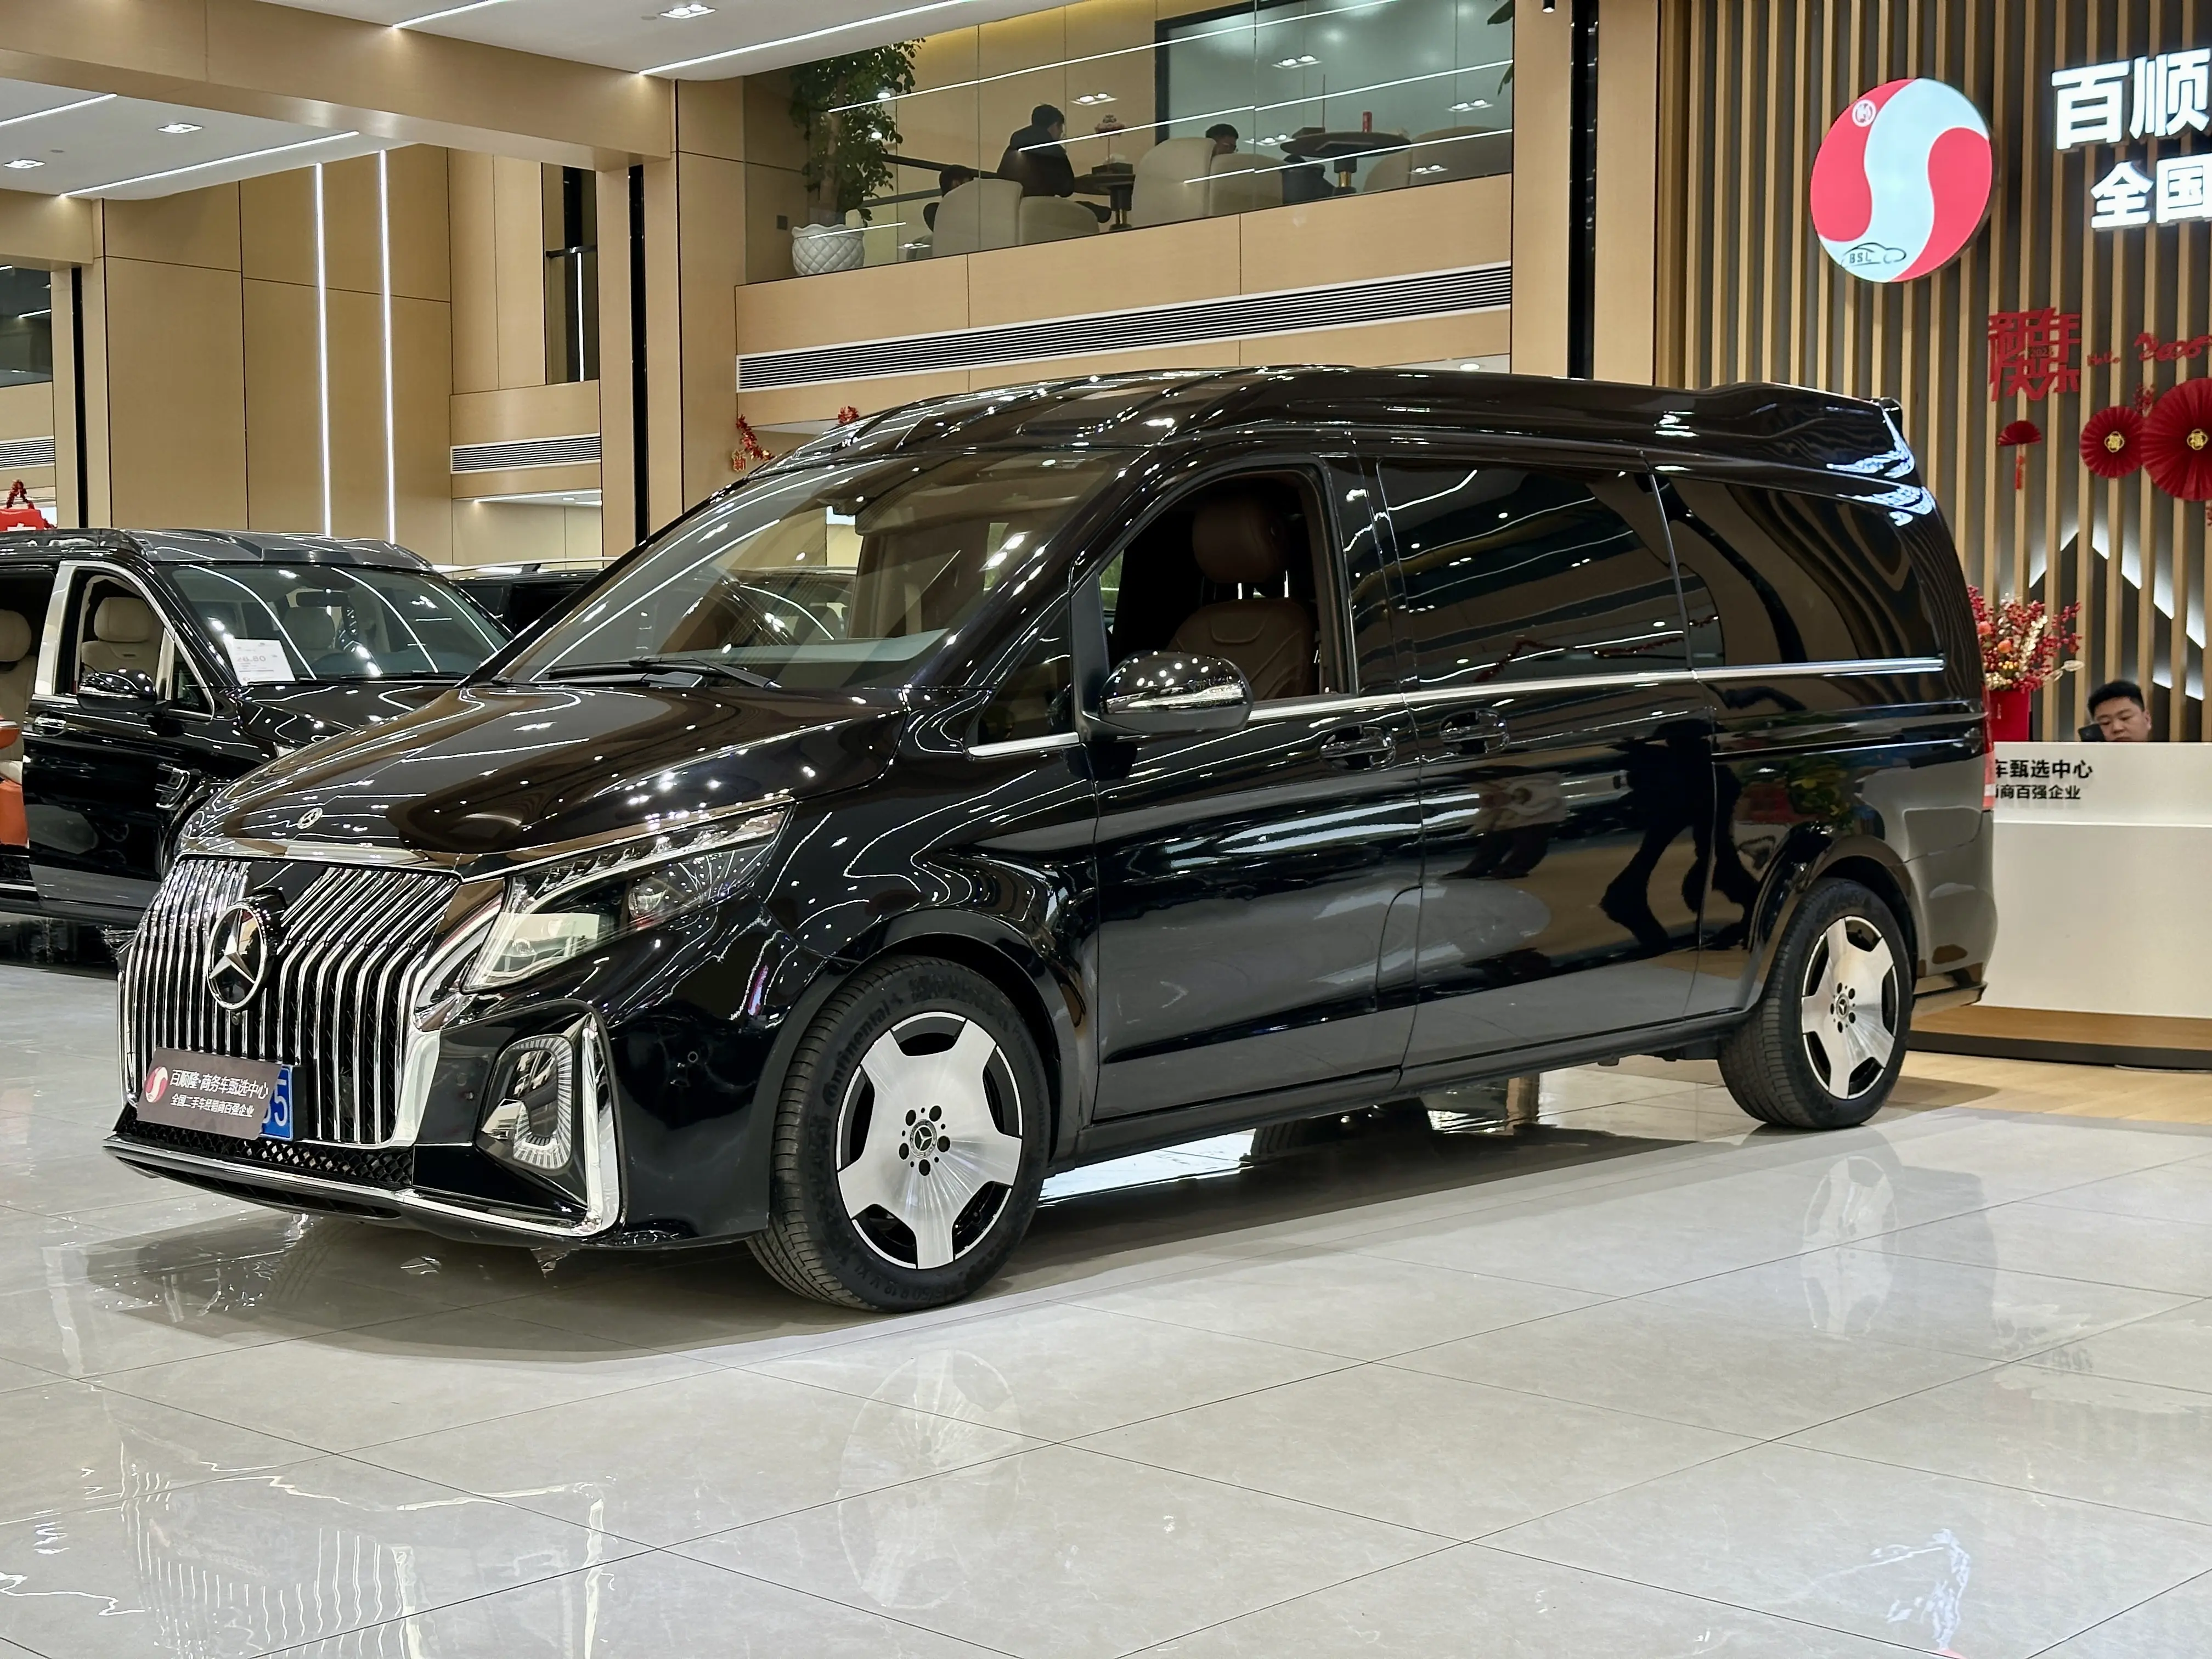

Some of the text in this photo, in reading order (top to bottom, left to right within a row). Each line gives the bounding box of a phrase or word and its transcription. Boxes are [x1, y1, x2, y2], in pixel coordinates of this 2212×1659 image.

[2051, 48, 2210, 150] 百顺
[2091, 154, 2212, 229] 全国
[1849, 252, 1872, 263] BSL
[1995, 785, 2081, 799] 商百强企业
[823, 999, 891, 1107] Continental
